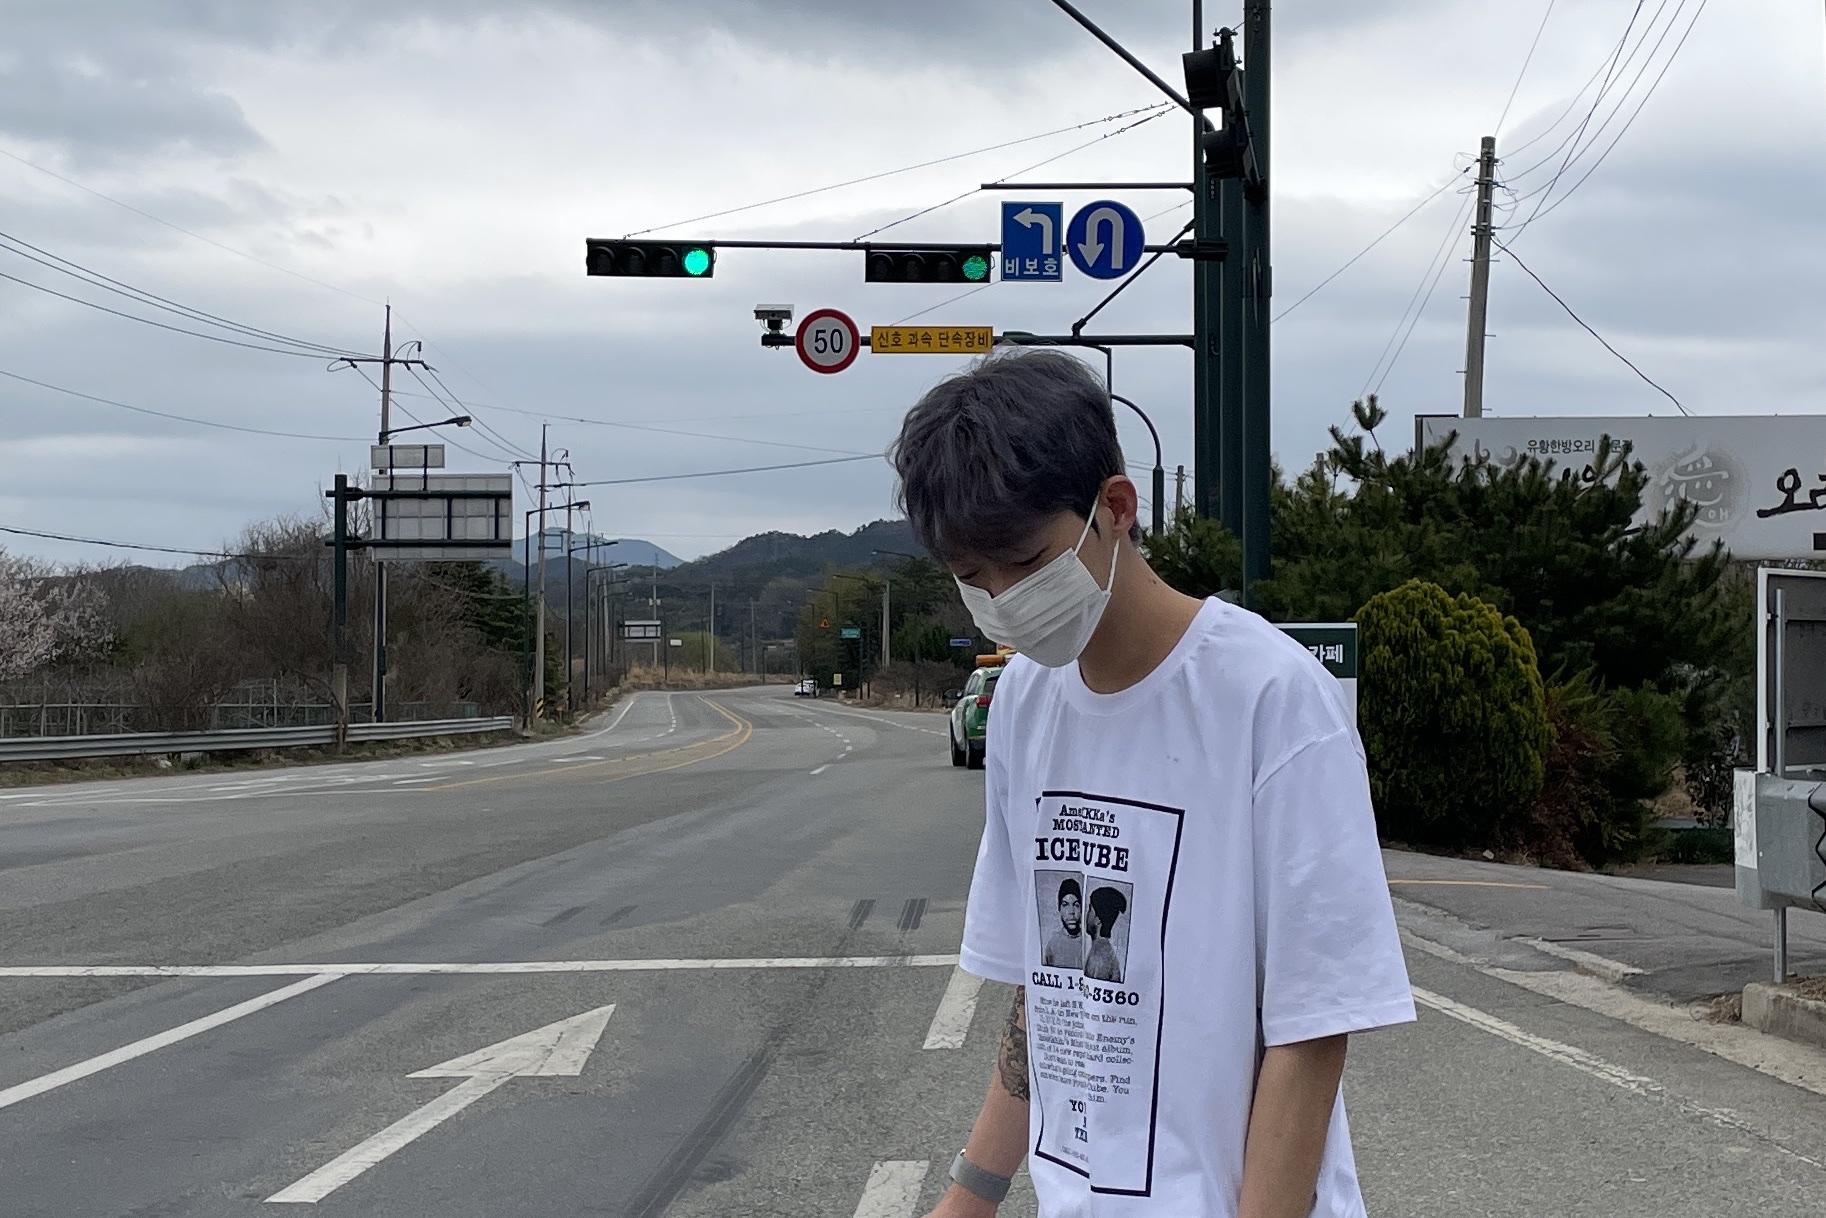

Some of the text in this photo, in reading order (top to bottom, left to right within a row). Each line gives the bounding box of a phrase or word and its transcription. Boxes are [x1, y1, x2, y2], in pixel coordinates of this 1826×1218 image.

[1005, 256, 1059, 277] 비보호
[813, 328, 844, 354] 50
[877, 331, 989, 348] 신호 과속 단속장비
[1527, 439, 1595, 454] 유황한방오리
[1032, 971, 1062, 989] CALL
[1102, 1014, 1117, 1024] the
[1096, 1032, 1135, 1046] Enemy's
[1113, 1085, 1130, 1095] You
